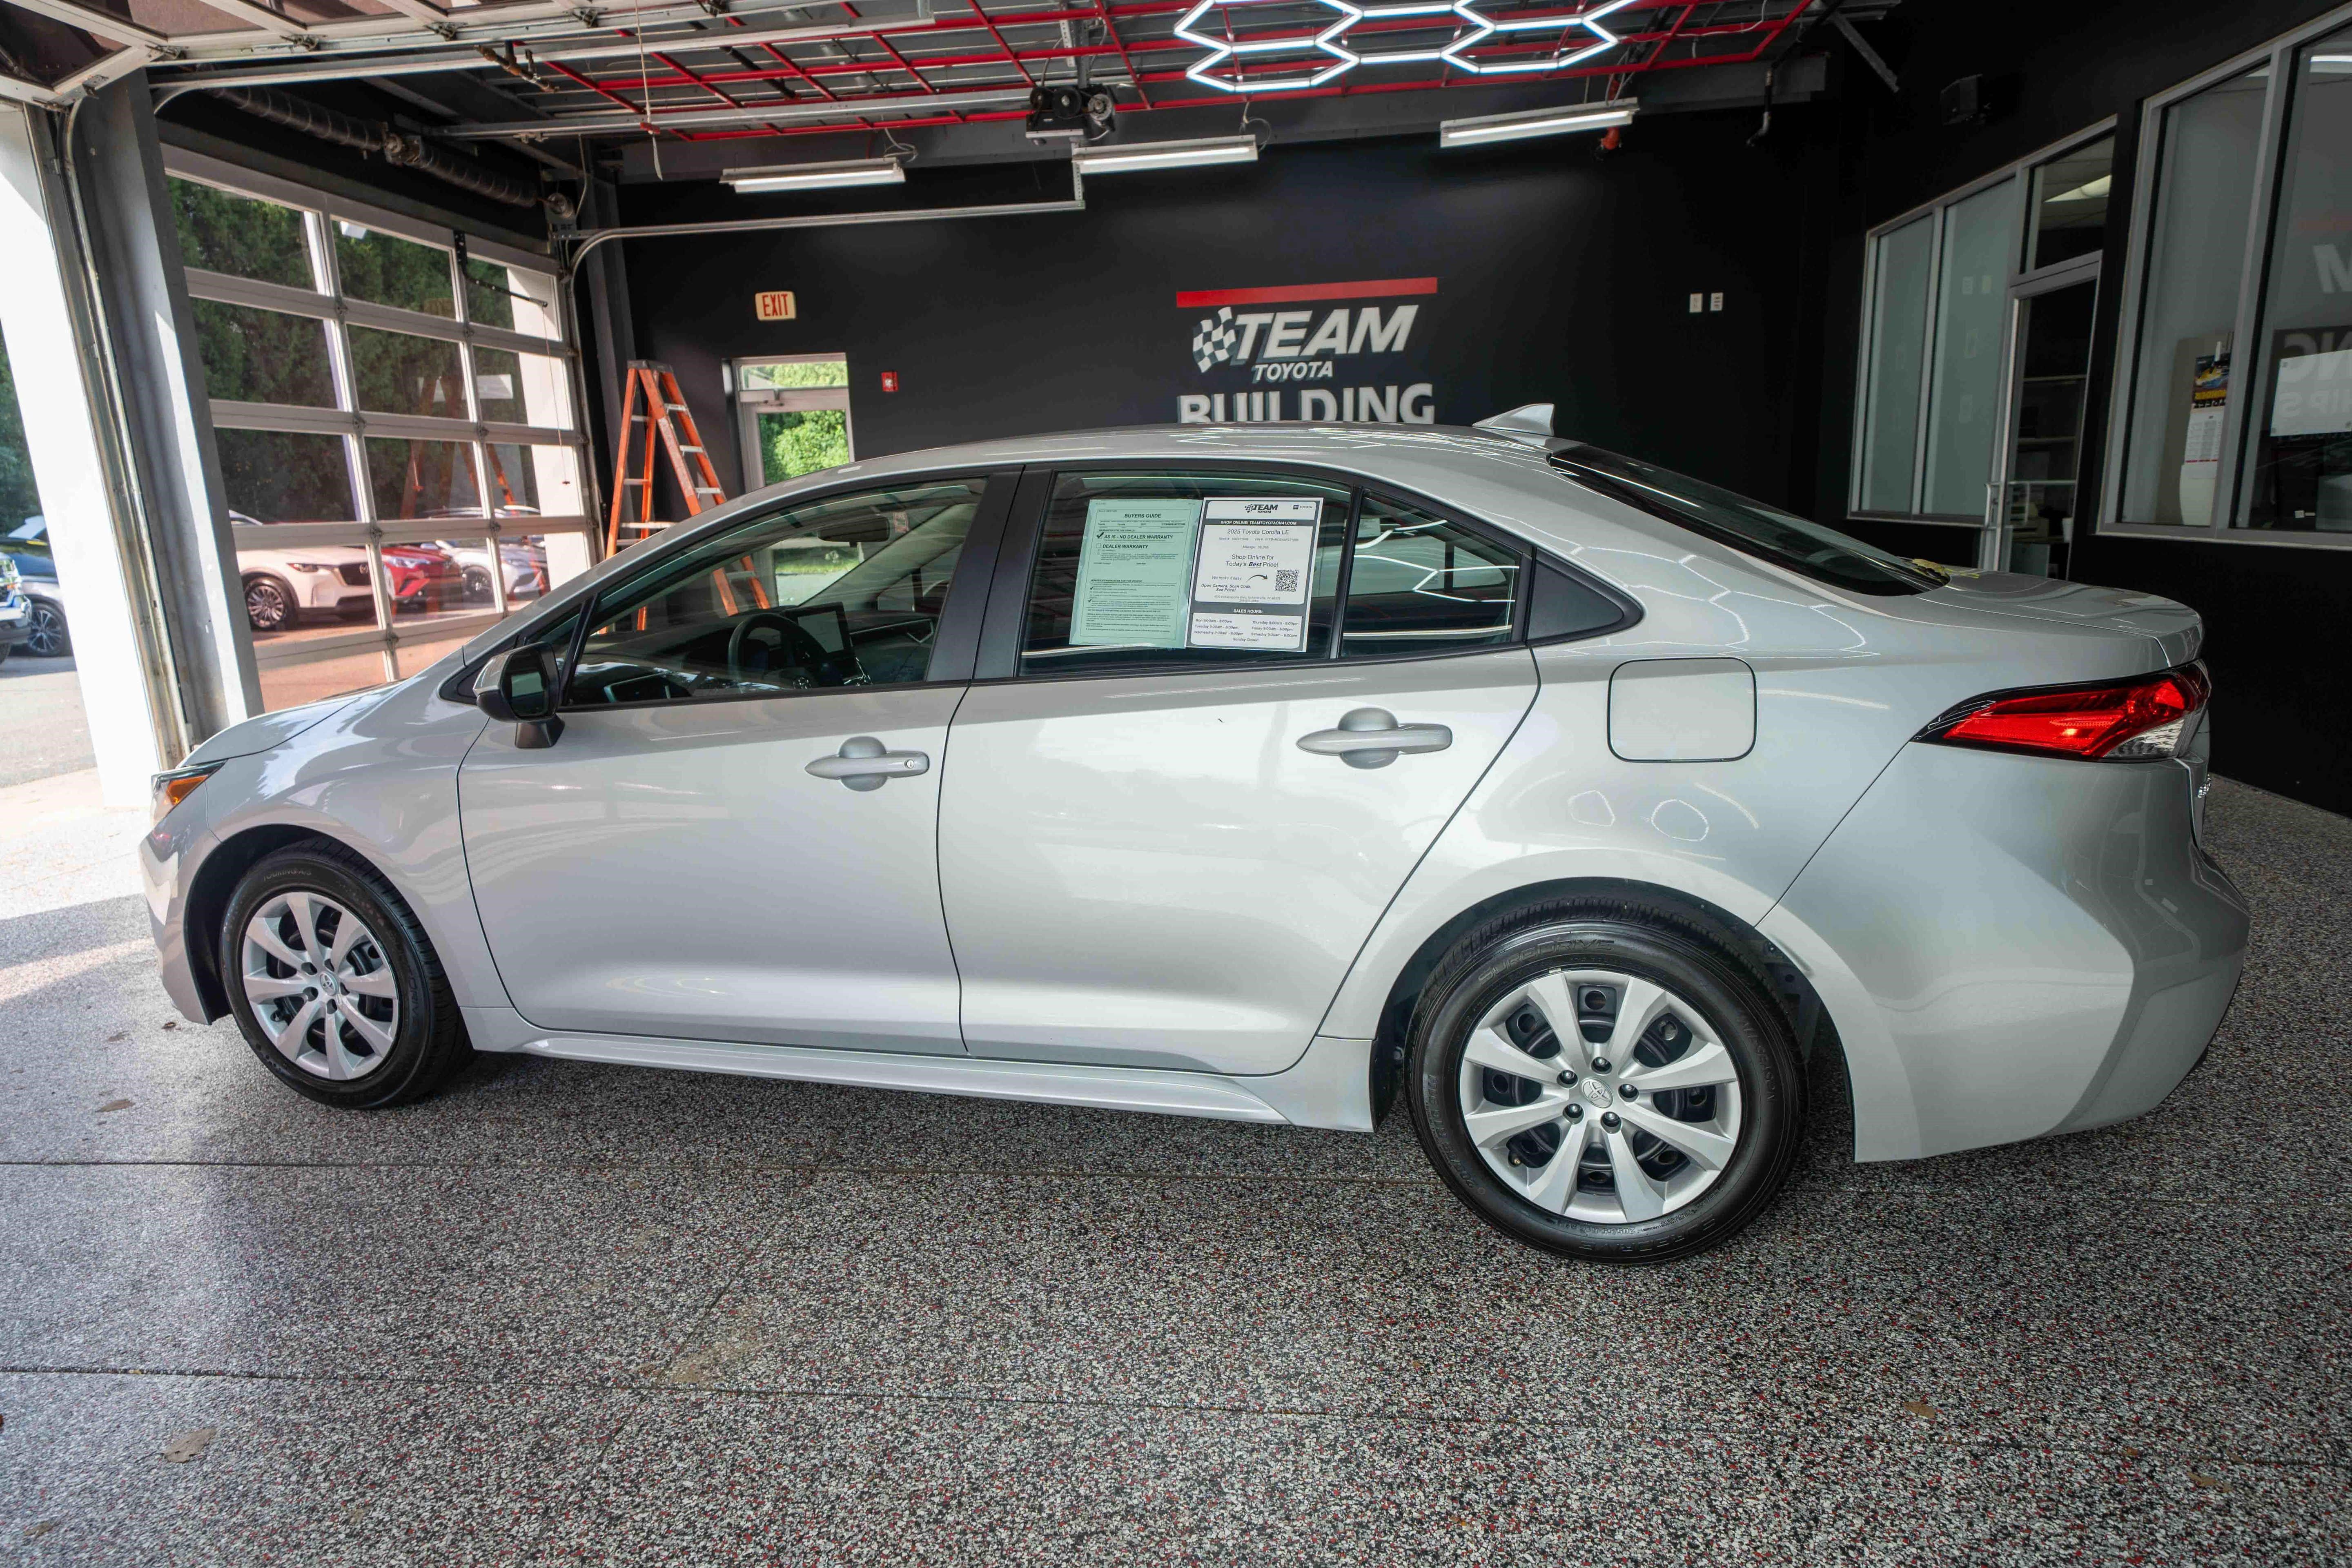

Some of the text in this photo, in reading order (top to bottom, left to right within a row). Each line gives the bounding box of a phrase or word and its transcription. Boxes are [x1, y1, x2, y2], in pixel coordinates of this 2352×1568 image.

[762, 293, 788, 317] EXIT
[1233, 304, 1419, 362] TEAM
[1253, 361, 1333, 382] TOYOTA
